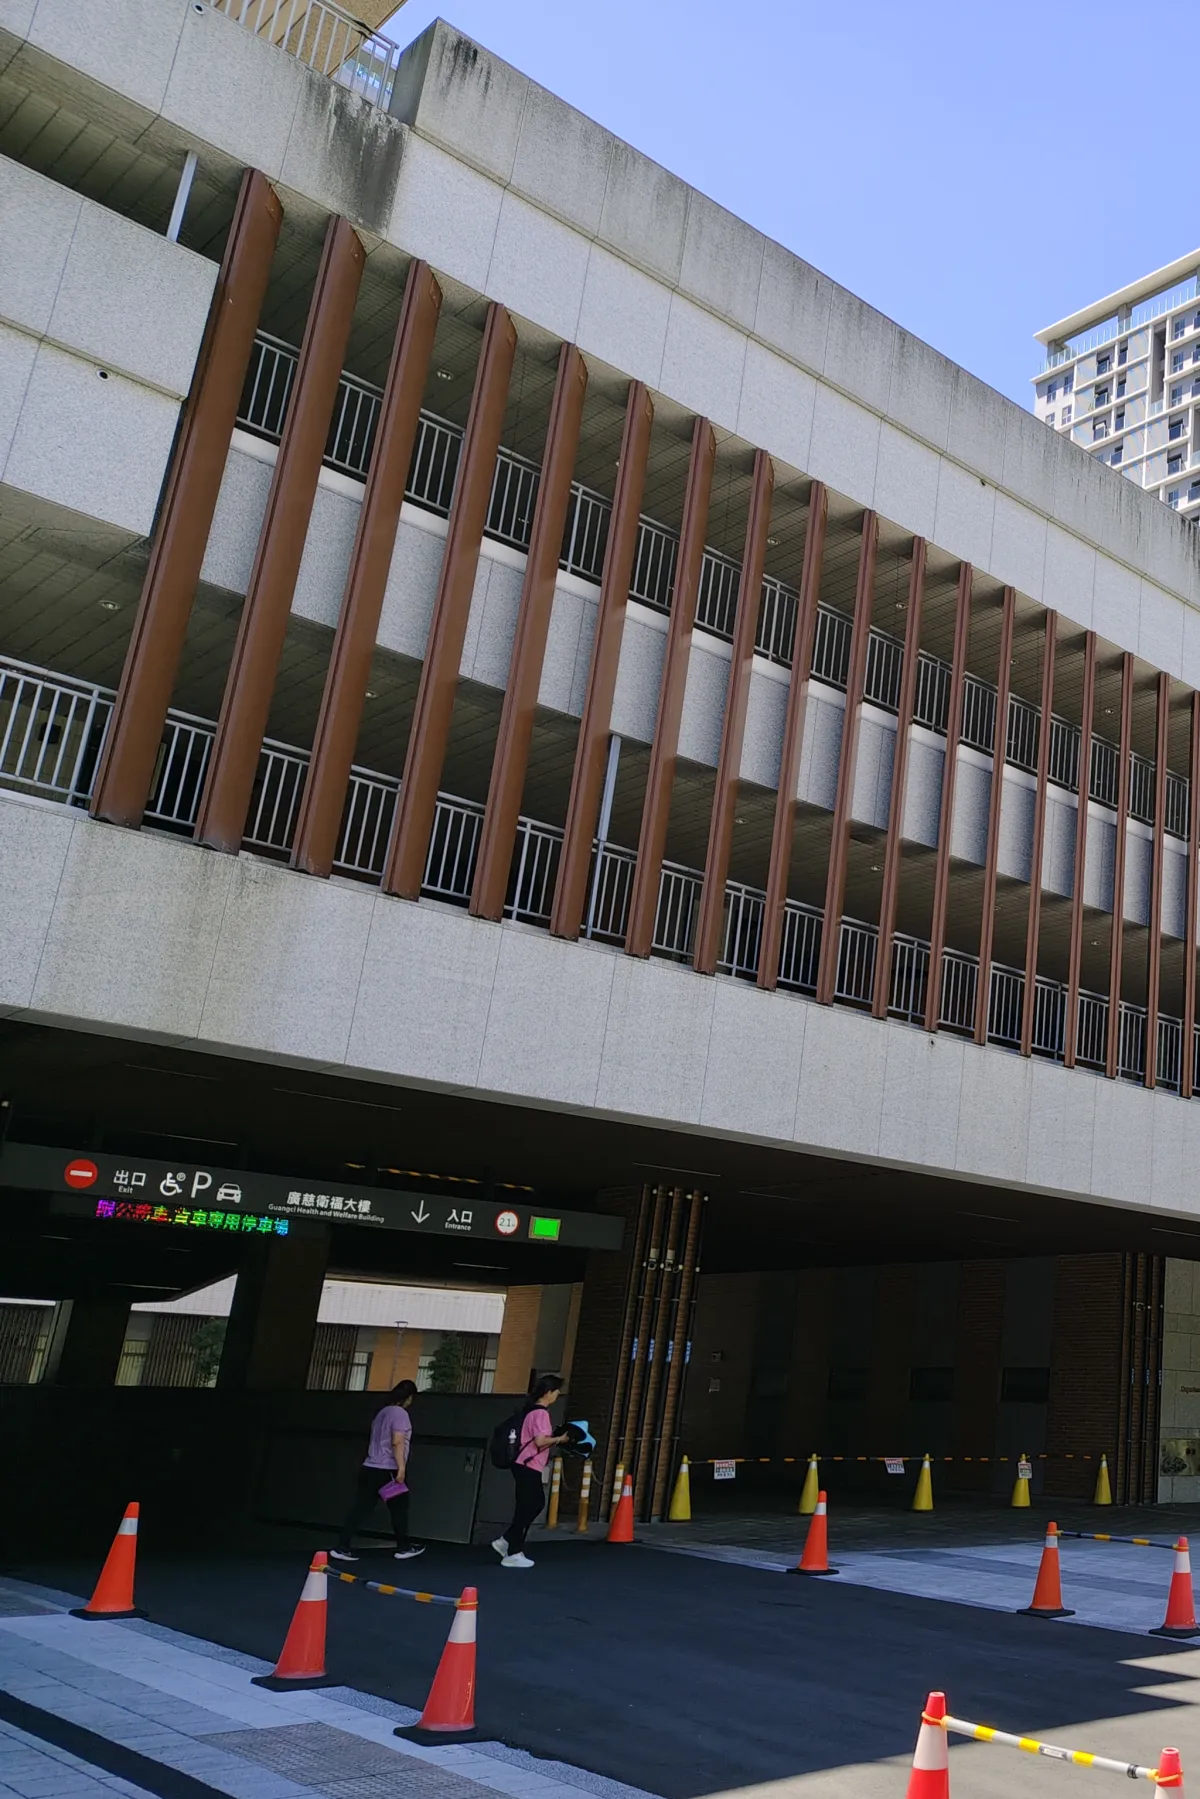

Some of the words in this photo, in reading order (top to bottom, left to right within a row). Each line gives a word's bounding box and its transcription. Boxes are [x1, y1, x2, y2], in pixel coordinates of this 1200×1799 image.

[113, 1169, 147, 1187] 出口
[118, 1185, 134, 1194] Exit
[286, 1191, 372, 1214] 廣慈衛福大樓
[268, 1203, 297, 1213] Guangci
[296, 1207, 319, 1215] Health
[319, 1209, 333, 1217] and
[332, 1210, 358, 1220] Welfare
[358, 1213, 386, 1224] Building
[446, 1208, 473, 1224] 入口
[444, 1221, 472, 1232] Entrance
